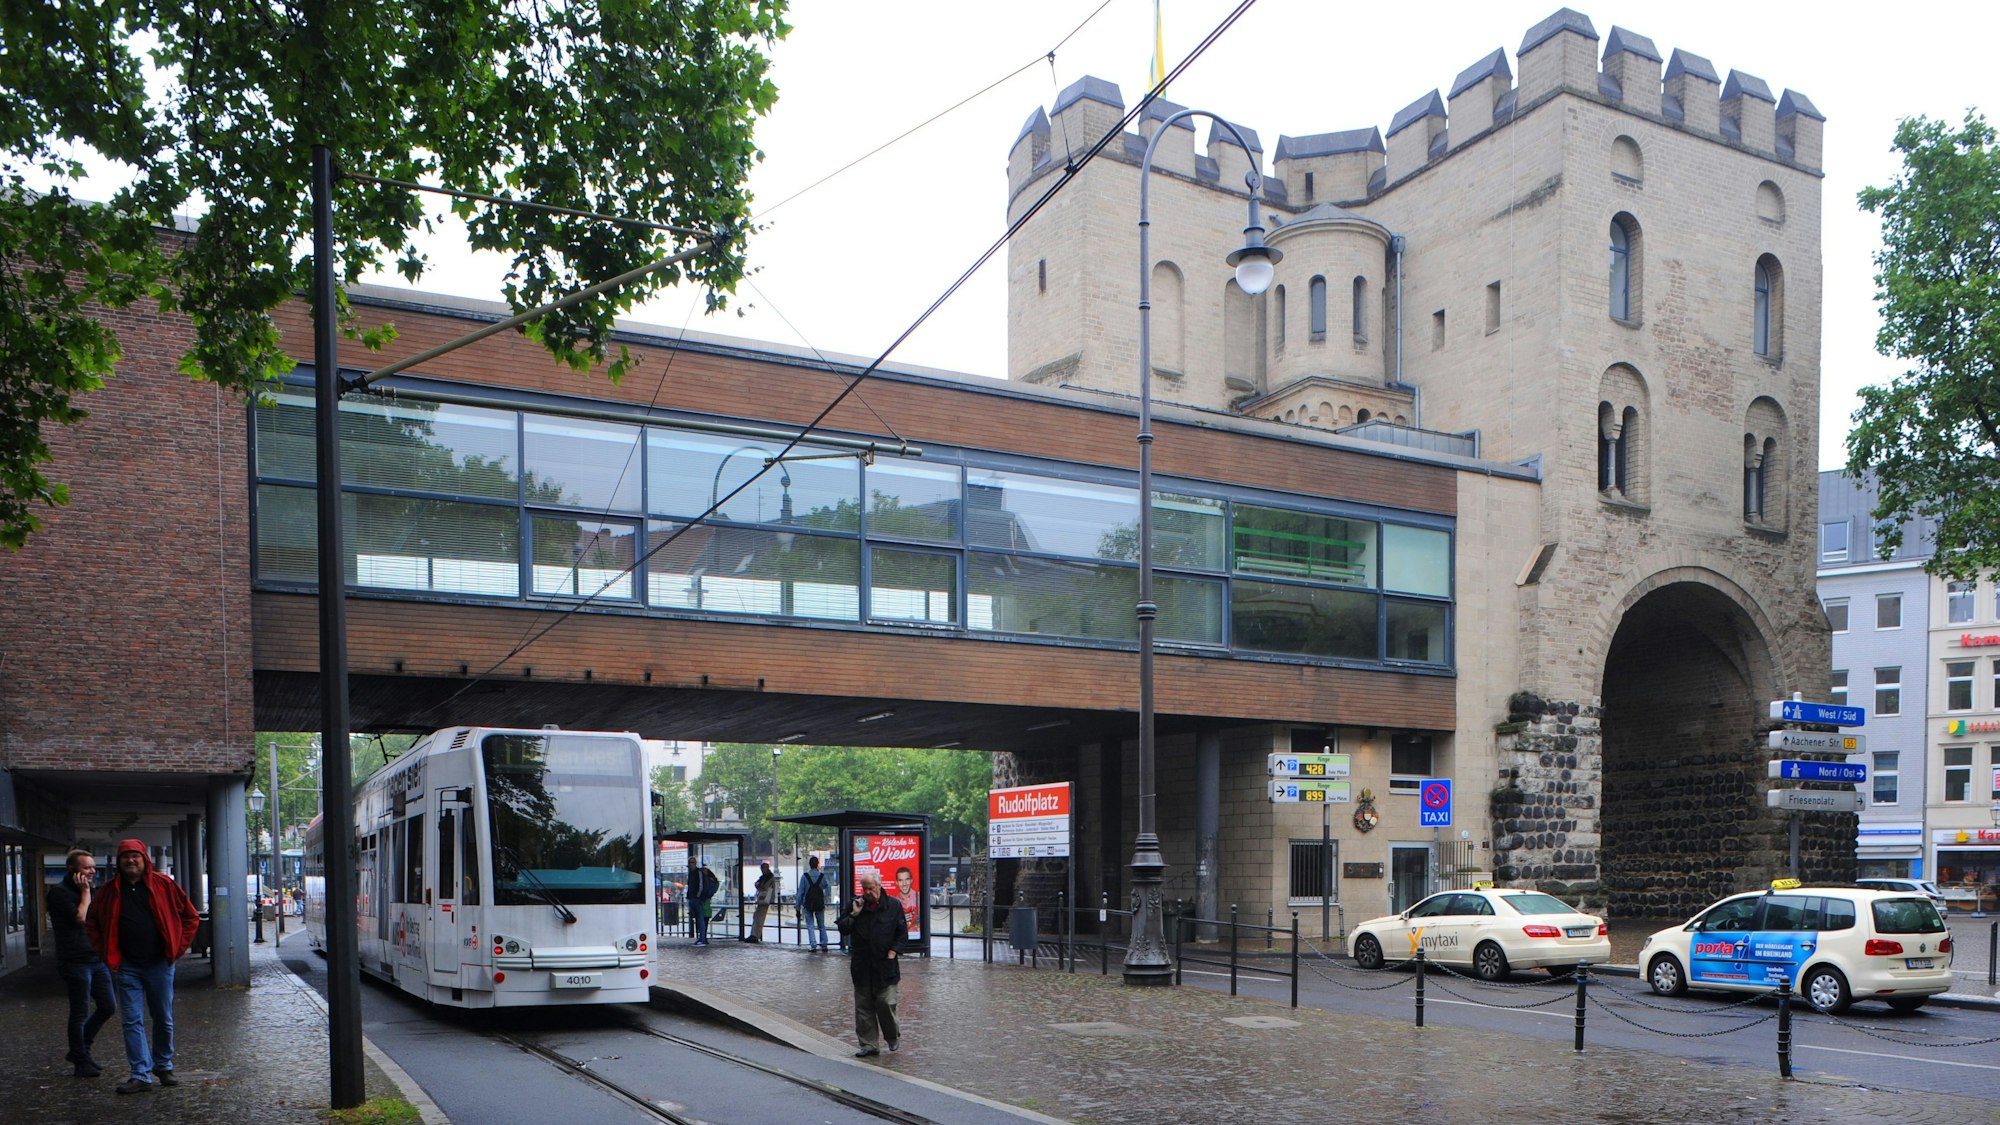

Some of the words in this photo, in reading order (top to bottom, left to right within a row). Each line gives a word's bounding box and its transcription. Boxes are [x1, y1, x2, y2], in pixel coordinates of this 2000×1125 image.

[1818, 708, 1836, 719] West
[1843, 710, 1856, 720] Süd
[1790, 736, 1825, 746] Aachener
[1829, 738, 1841, 748] Str.
[1846, 739, 1854, 747] 55
[1305, 764, 1324, 775] 428
[1818, 767, 1837, 777] Nord
[1843, 768, 1856, 778] Ost
[1305, 791, 1324, 801] 899
[1788, 794, 1835, 806] Friesenplatz
[998, 793, 1059, 815] Rudolfplatz
[1423, 811, 1449, 823] TAXI
[872, 846, 916, 863] Wiesn
[1421, 931, 1458, 951] mytaxi
[1695, 941, 1734, 955] porta
[566, 975, 591, 986] 4010
